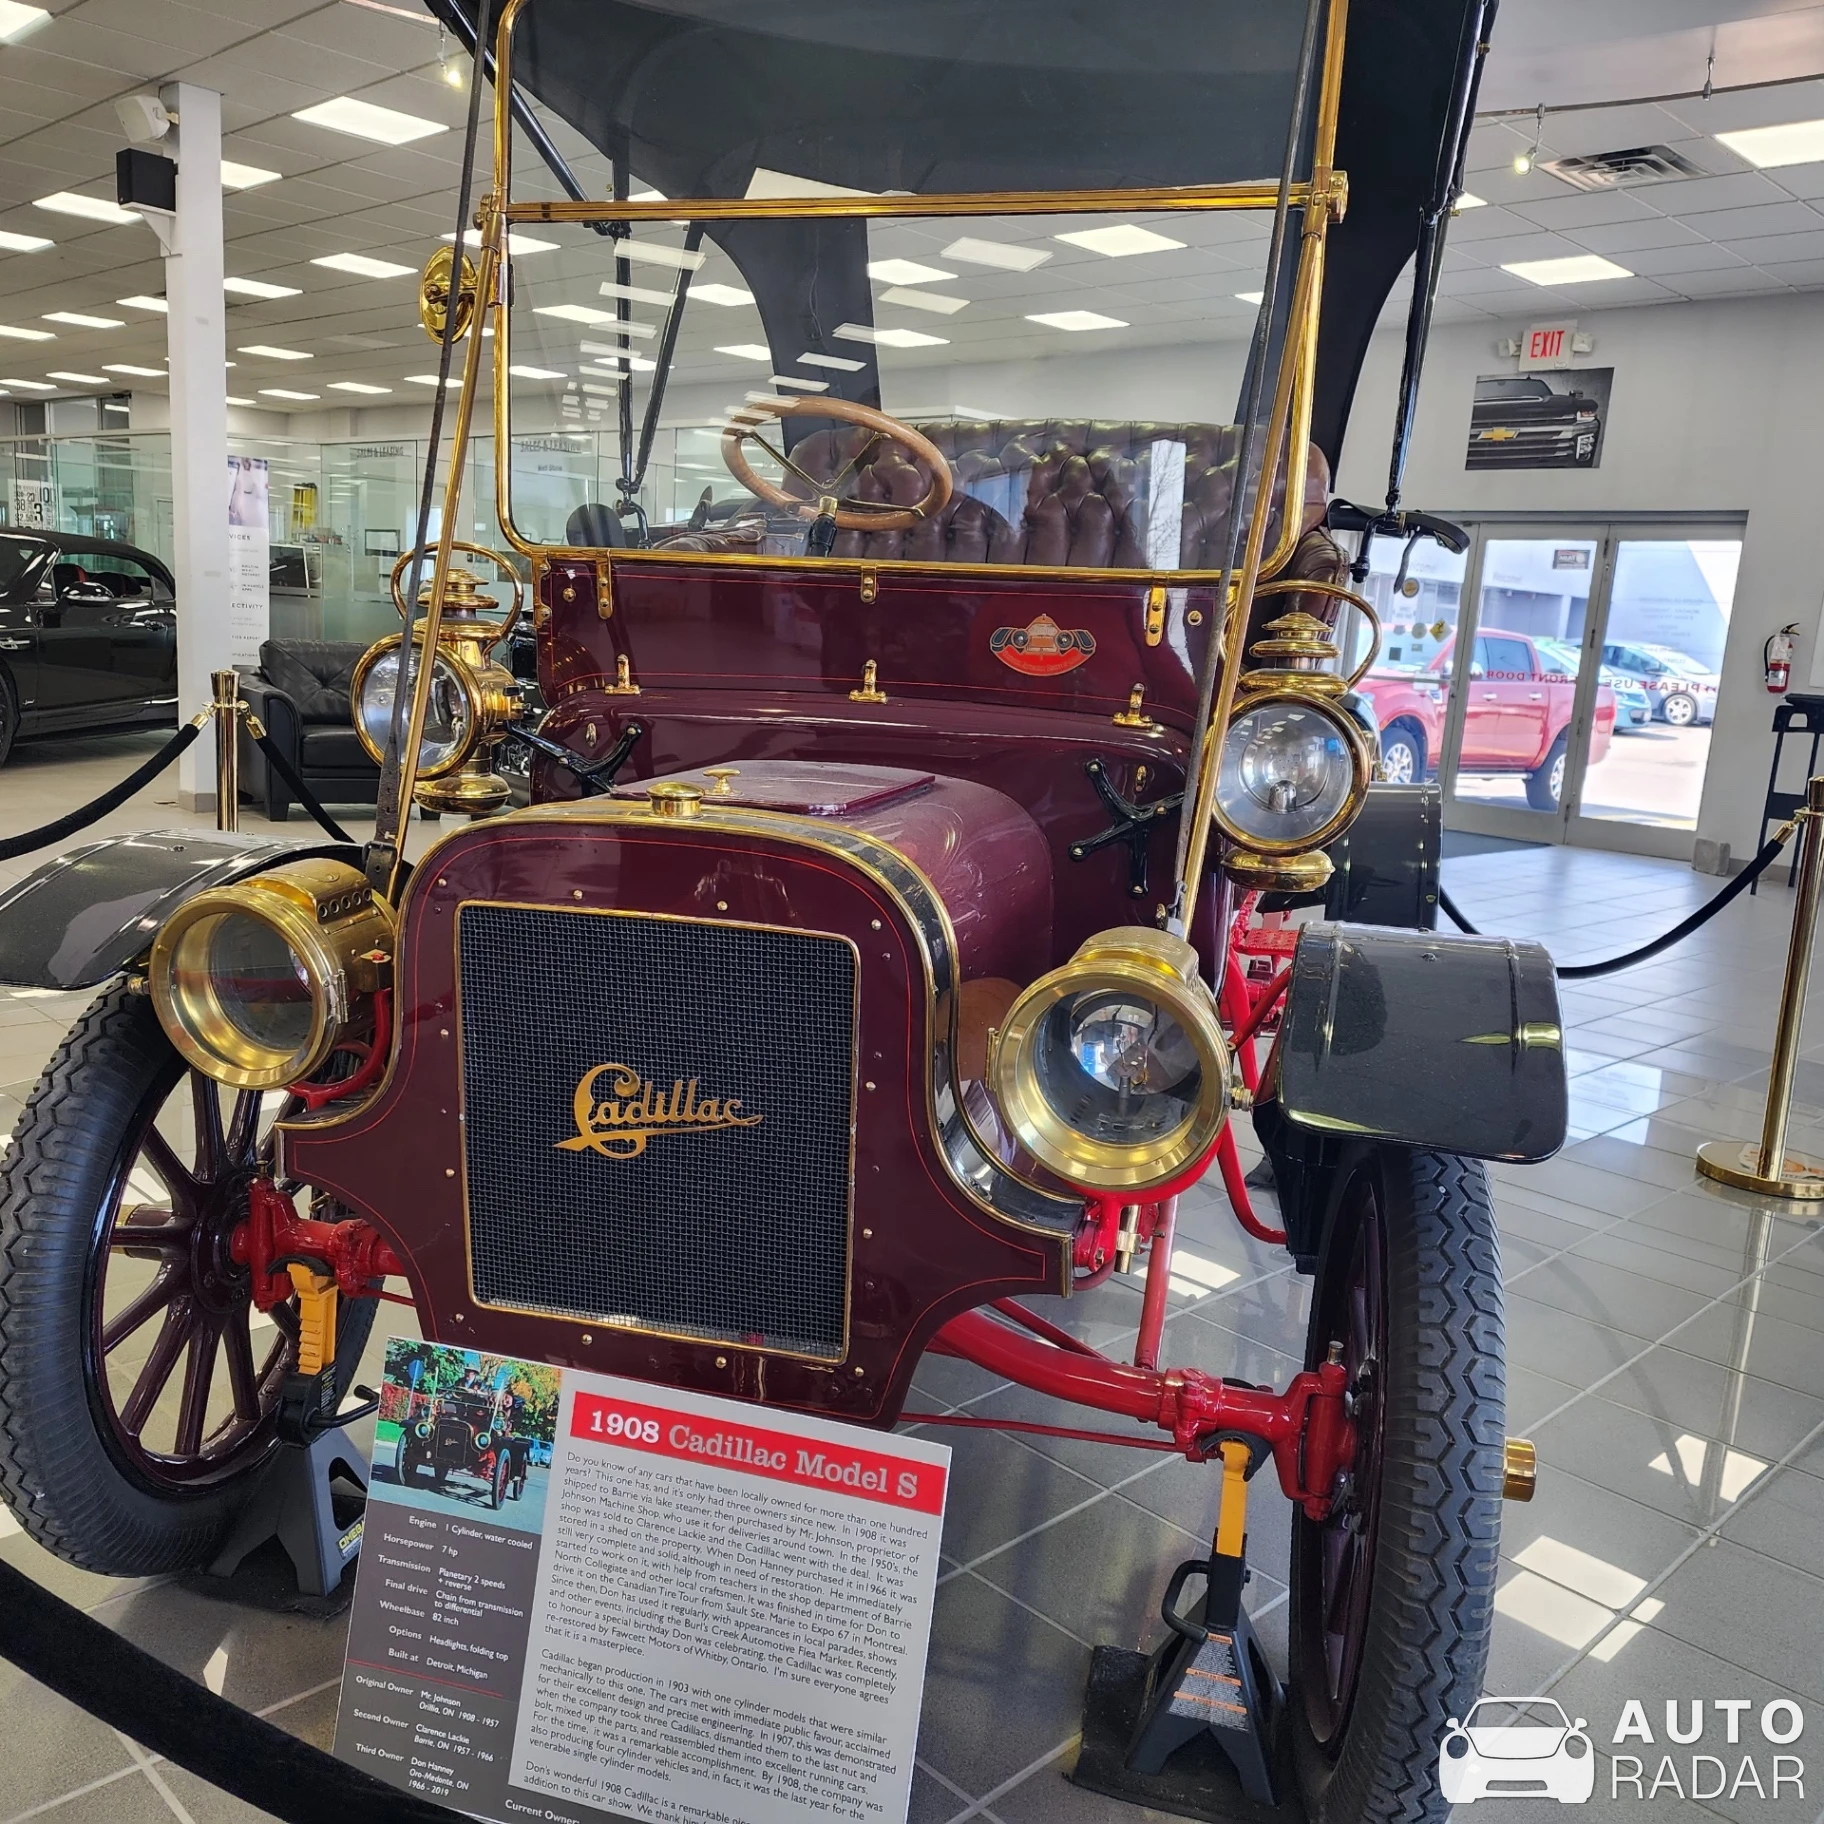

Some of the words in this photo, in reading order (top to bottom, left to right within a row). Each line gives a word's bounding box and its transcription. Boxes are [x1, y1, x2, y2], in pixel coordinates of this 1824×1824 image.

[1530, 330, 1565, 358] EXIT
[552, 1063, 764, 1159] Cadillac
[590, 1410, 659, 1444] 1908
[669, 1424, 787, 1470] Cadillac
[794, 1449, 888, 1495] Model
[896, 1472, 919, 1499] S
[564, 1466, 591, 1477] years?
[594, 1471, 613, 1482] This
[615, 1477, 633, 1486] one
[653, 1485, 669, 1494] and
[672, 1487, 683, 1497] it's
[686, 1492, 706, 1504] only
[707, 1494, 724, 1506] had
[726, 1499, 751, 1512] three
[753, 1507, 787, 1520] owners
[789, 1513, 813, 1526] since
[842, 1524, 851, 1535] In
[855, 1526, 877, 1541] 1908
[879, 1533, 886, 1543] it
[888, 1537, 907, 1548] was
[567, 1451, 581, 1462] Do
[582, 1457, 599, 1466] you
[601, 1458, 625, 1471] know
[627, 1465, 637, 1474] of
[638, 1469, 653, 1480] any
[655, 1472, 673, 1483] cars
[675, 1475, 693, 1487] that
[694, 1479, 714, 1491] have
[716, 1483, 738, 1496] been
[740, 1488, 768, 1505] locally
[770, 1498, 802, 1511] owned
[803, 1502, 817, 1513] for
[819, 1508, 844, 1520] more
[846, 1512, 866, 1525] than
[869, 1520, 887, 1530] one
[889, 1521, 928, 1539] hundred
[383, 1532, 434, 1550] Horsepower
[441, 1544, 447, 1553] 7
[448, 1546, 458, 1557] hp
[408, 1515, 437, 1528] Engine
[484, 1533, 506, 1543] water
[507, 1538, 533, 1550] cooled
[377, 1553, 431, 1572] Transmission
[438, 1566, 472, 1583] Planetary
[473, 1574, 479, 1584] 2
[480, 1578, 505, 1589] speeds
[444, 1580, 472, 1591] reverse
[379, 1599, 425, 1617] Wheelbase
[431, 1612, 442, 1622] 82
[443, 1615, 459, 1626] inch
[385, 1578, 406, 1590] Final
[406, 1583, 428, 1595] drive
[435, 1589, 457, 1602] Chain
[458, 1594, 476, 1606] from
[478, 1601, 523, 1617] transmission
[434, 1600, 443, 1608] to
[444, 1601, 483, 1617] differential
[552, 1562, 574, 1575] drive
[576, 1567, 583, 1577] it
[585, 1571, 597, 1580] on
[599, 1573, 614, 1584] the
[616, 1576, 657, 1594] Canadian
[658, 1585, 677, 1599] Tire
[677, 1590, 699, 1603] Tour
[701, 1596, 723, 1610] from
[725, 1602, 748, 1616] Sault
[769, 1612, 795, 1627] Marie
[798, 1621, 808, 1630] to
[811, 1622, 835, 1637] Expo
[837, 1629, 850, 1640] 67
[852, 1632, 860, 1643] in
[388, 1625, 422, 1640] Options
[469, 1643, 494, 1659] folding
[495, 1651, 509, 1662] top
[388, 1647, 408, 1659] Built
[409, 1654, 419, 1662] at
[456, 1663, 488, 1679] Michigan
[355, 1675, 386, 1688] Original
[387, 1682, 414, 1695] Owner
[432, 1693, 461, 1707] Johnson
[541, 1648, 575, 1665] Cadillac
[577, 1656, 602, 1672] began
[604, 1666, 653, 1684] production
[655, 1677, 664, 1687] in
[668, 1679, 689, 1693] 1903
[691, 1687, 711, 1699] with
[713, 1694, 732, 1704] one
[733, 1698, 771, 1713] cylinder
[772, 1708, 806, 1723] models
[808, 1715, 827, 1729] that
[829, 1723, 854, 1736] were
[856, 1729, 887, 1744] similar
[353, 1708, 381, 1722] Second
[382, 1715, 409, 1728] Owner
[415, 1723, 446, 1738] Clarence
[447, 1731, 469, 1744] Lackie
[442, 1706, 455, 1717] ON
[458, 1711, 476, 1722] 1908
[481, 1717, 499, 1728] 1957
[355, 1742, 377, 1755] Third
[377, 1748, 404, 1761] Owner
[410, 1756, 427, 1767] Don
[427, 1760, 454, 1776] Hanney
[436, 1740, 450, 1750] ON
[453, 1744, 471, 1755] 1957
[476, 1750, 493, 1762] 1966
[529, 1737, 571, 1755] venerable
[573, 1748, 597, 1762] single
[599, 1756, 635, 1771] cylinder
[408, 1779, 425, 1791] 1966
[431, 1785, 450, 1797] 2019
[456, 1780, 470, 1791] ON
[505, 1799, 543, 1817] Current
